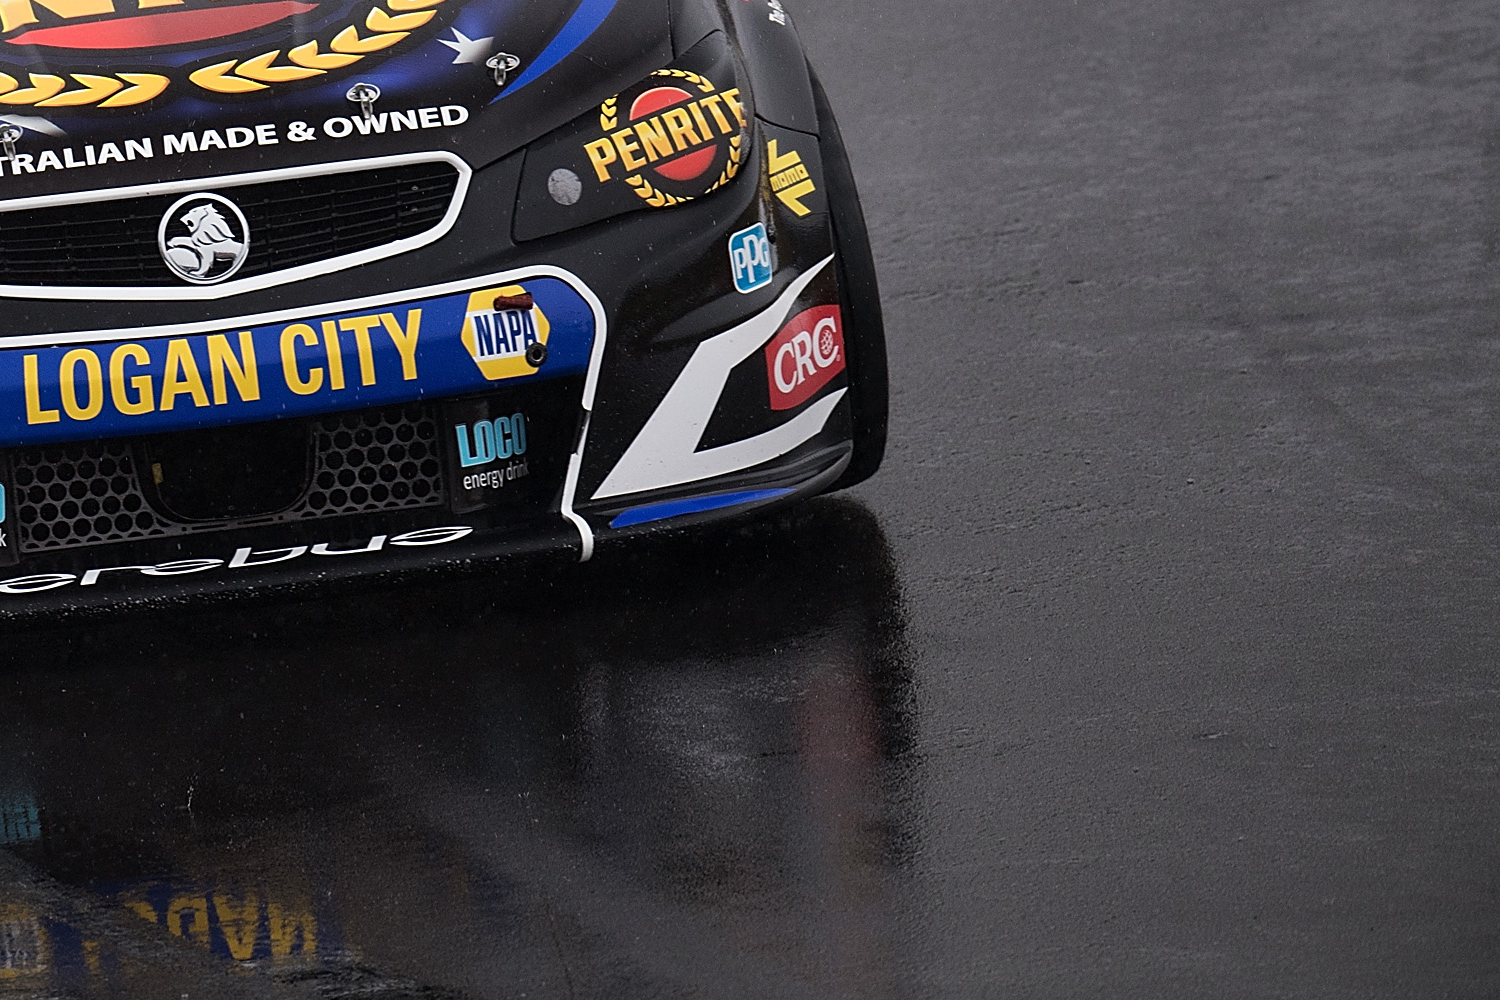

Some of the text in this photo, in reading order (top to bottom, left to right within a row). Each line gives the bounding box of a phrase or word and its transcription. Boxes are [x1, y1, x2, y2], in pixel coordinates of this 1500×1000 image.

[163, 123, 278, 155] MADE
[287, 118, 316, 143] &
[323, 104, 469, 140] OWNED
[583, 87, 746, 183] PENRITE
[733, 234, 770, 284] PPG
[474, 308, 536, 357] NAPA
[773, 315, 840, 394] CRC
[23, 309, 423, 425] LOGAN CITY
[455, 412, 527, 468] LOCO
[462, 465, 505, 491] energy
